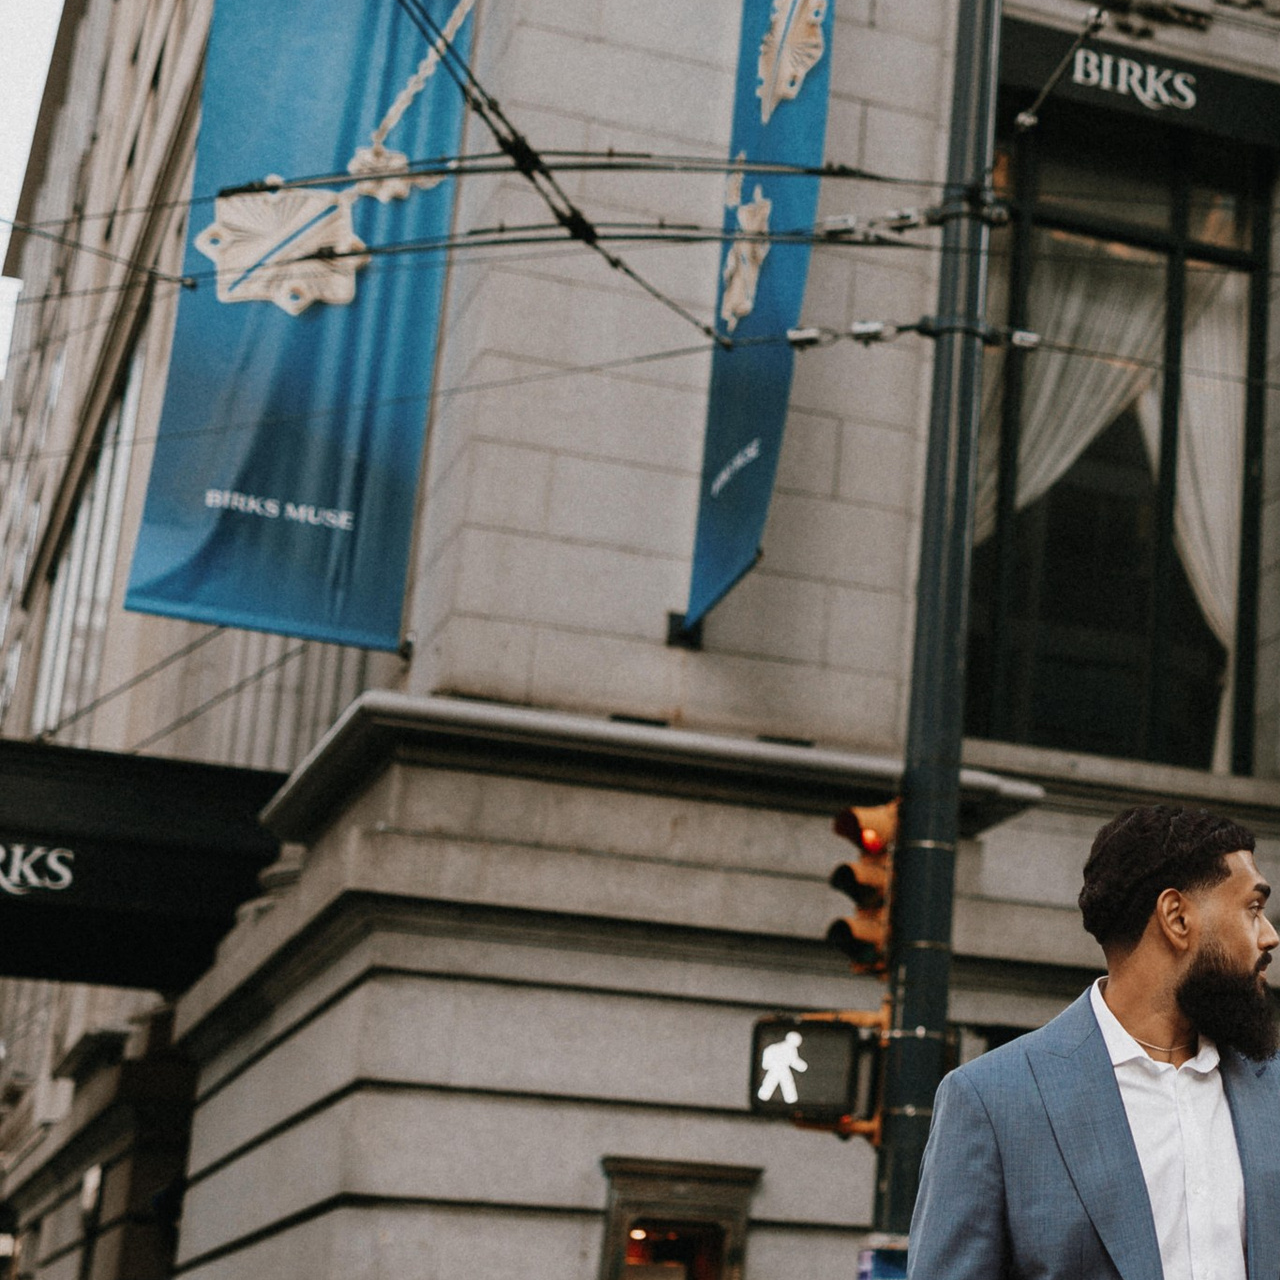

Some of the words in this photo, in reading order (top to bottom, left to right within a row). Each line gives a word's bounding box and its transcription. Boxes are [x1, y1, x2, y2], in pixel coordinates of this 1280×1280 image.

[1073, 48, 1197, 110] BIRKS
[205, 489, 280, 518] BIRKS
[285, 502, 355, 531] MUSE
[0, 842, 75, 895] KS
